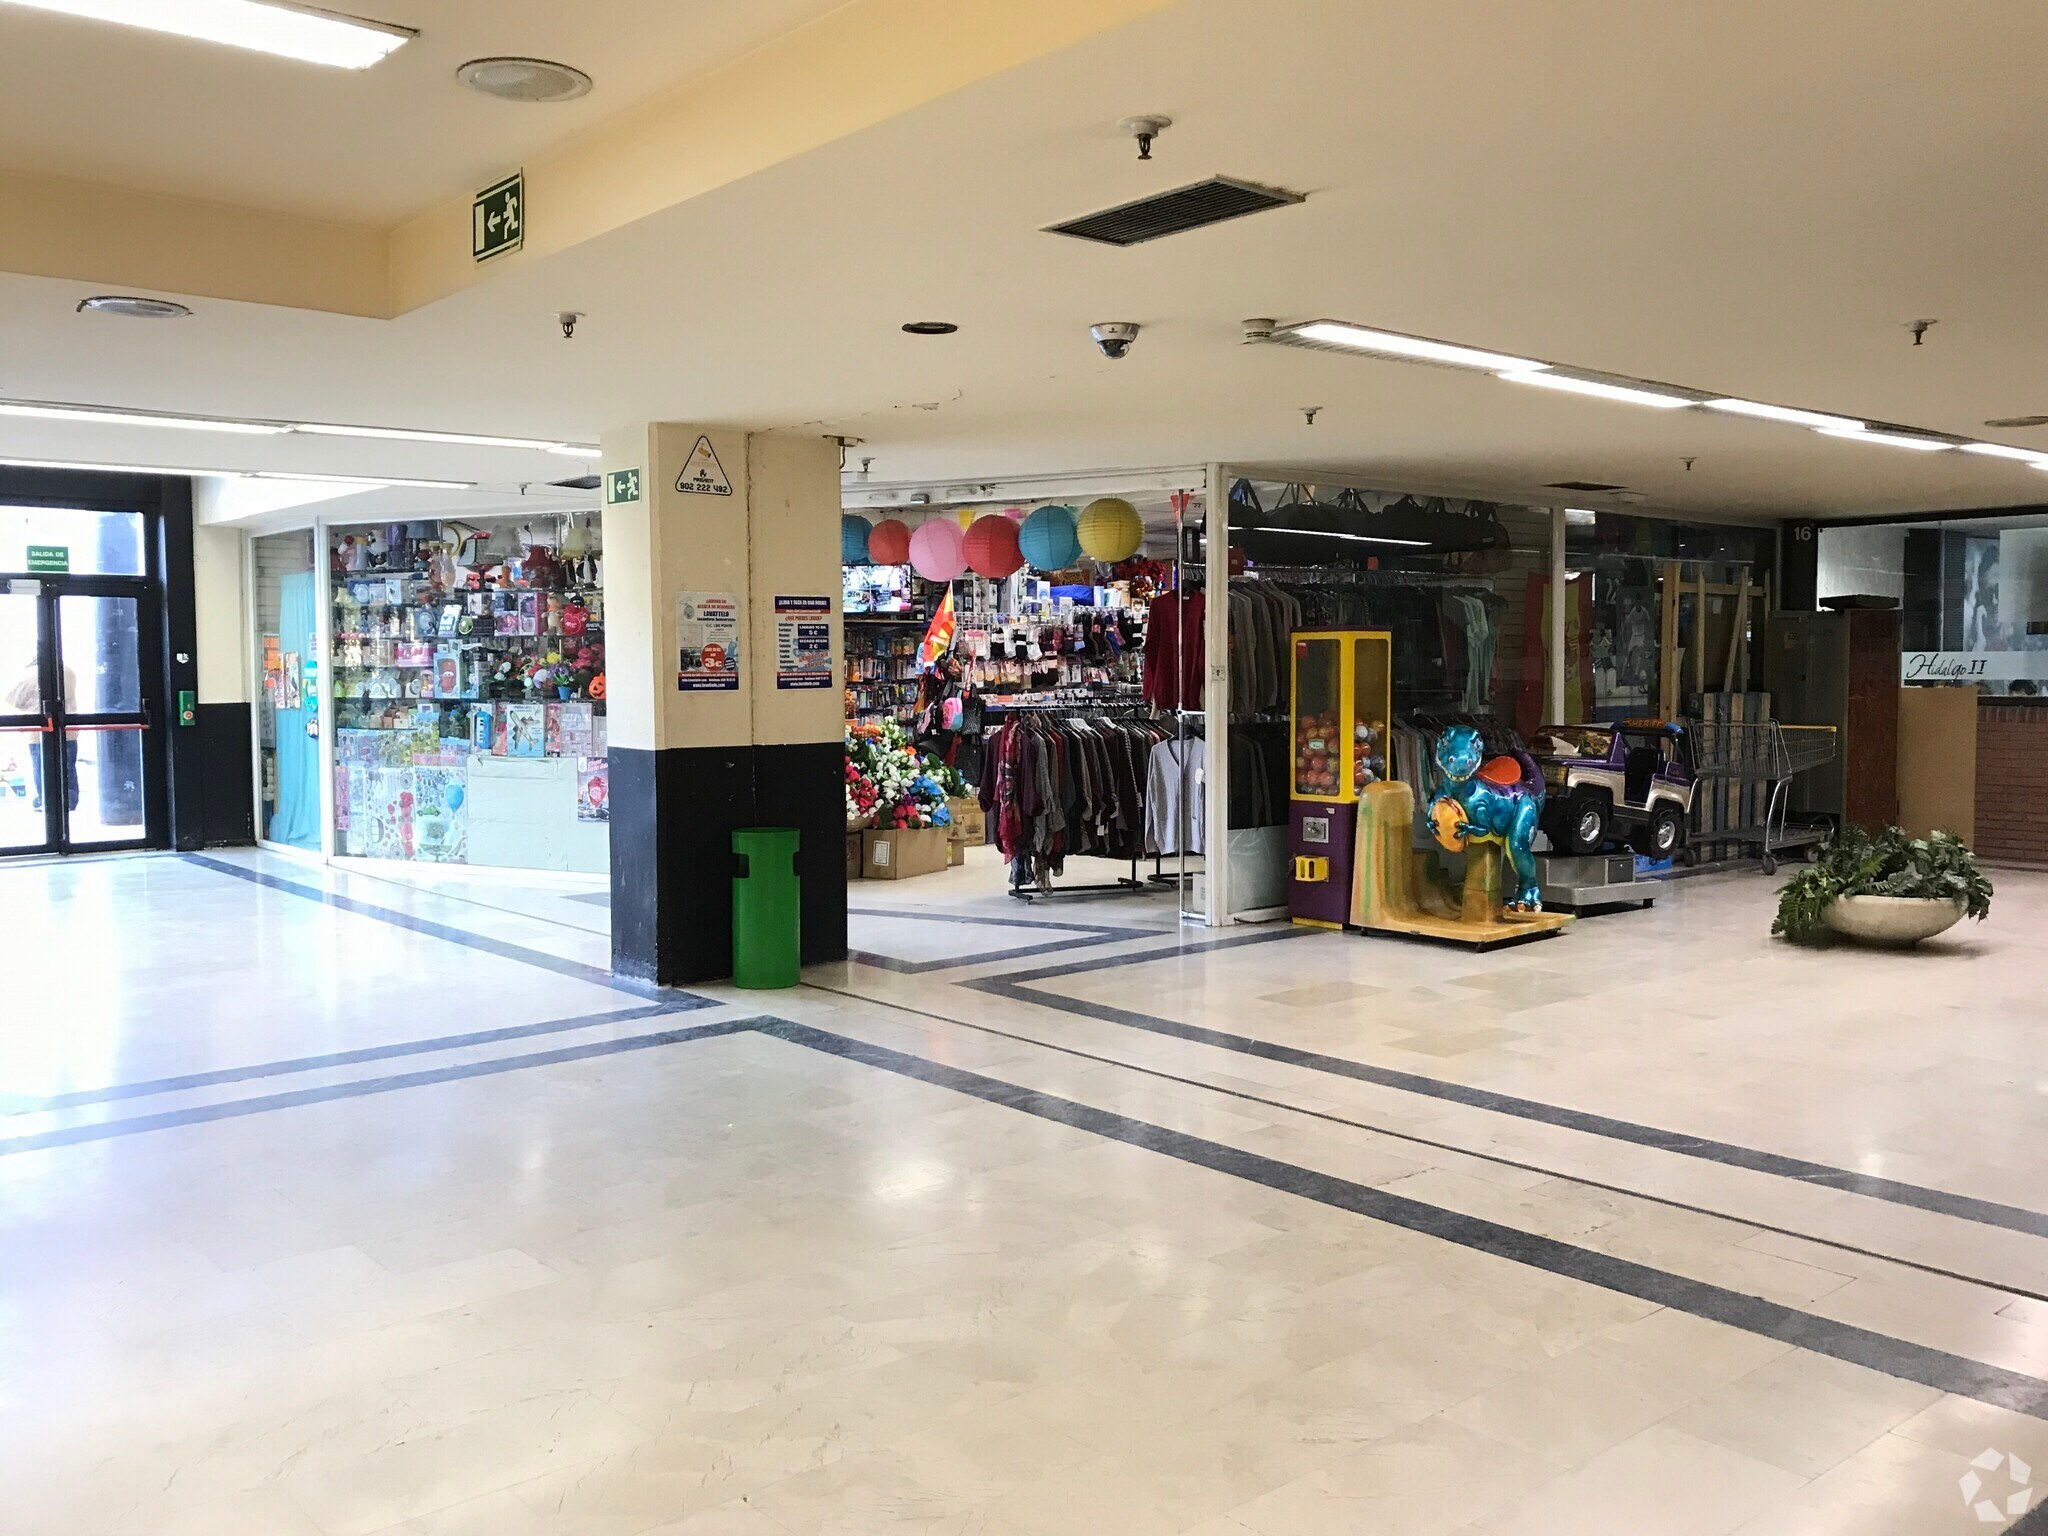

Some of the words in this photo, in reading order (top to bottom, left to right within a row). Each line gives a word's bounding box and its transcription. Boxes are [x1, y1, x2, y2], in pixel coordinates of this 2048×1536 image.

[680, 482, 694, 490] 902
[696, 483, 711, 492] 222
[1794, 526, 1812, 541] 16
[1906, 653, 1967, 680] Hidalgo
[1967, 659, 1988, 675] II
[1628, 719, 1662, 728] SHERIFF
